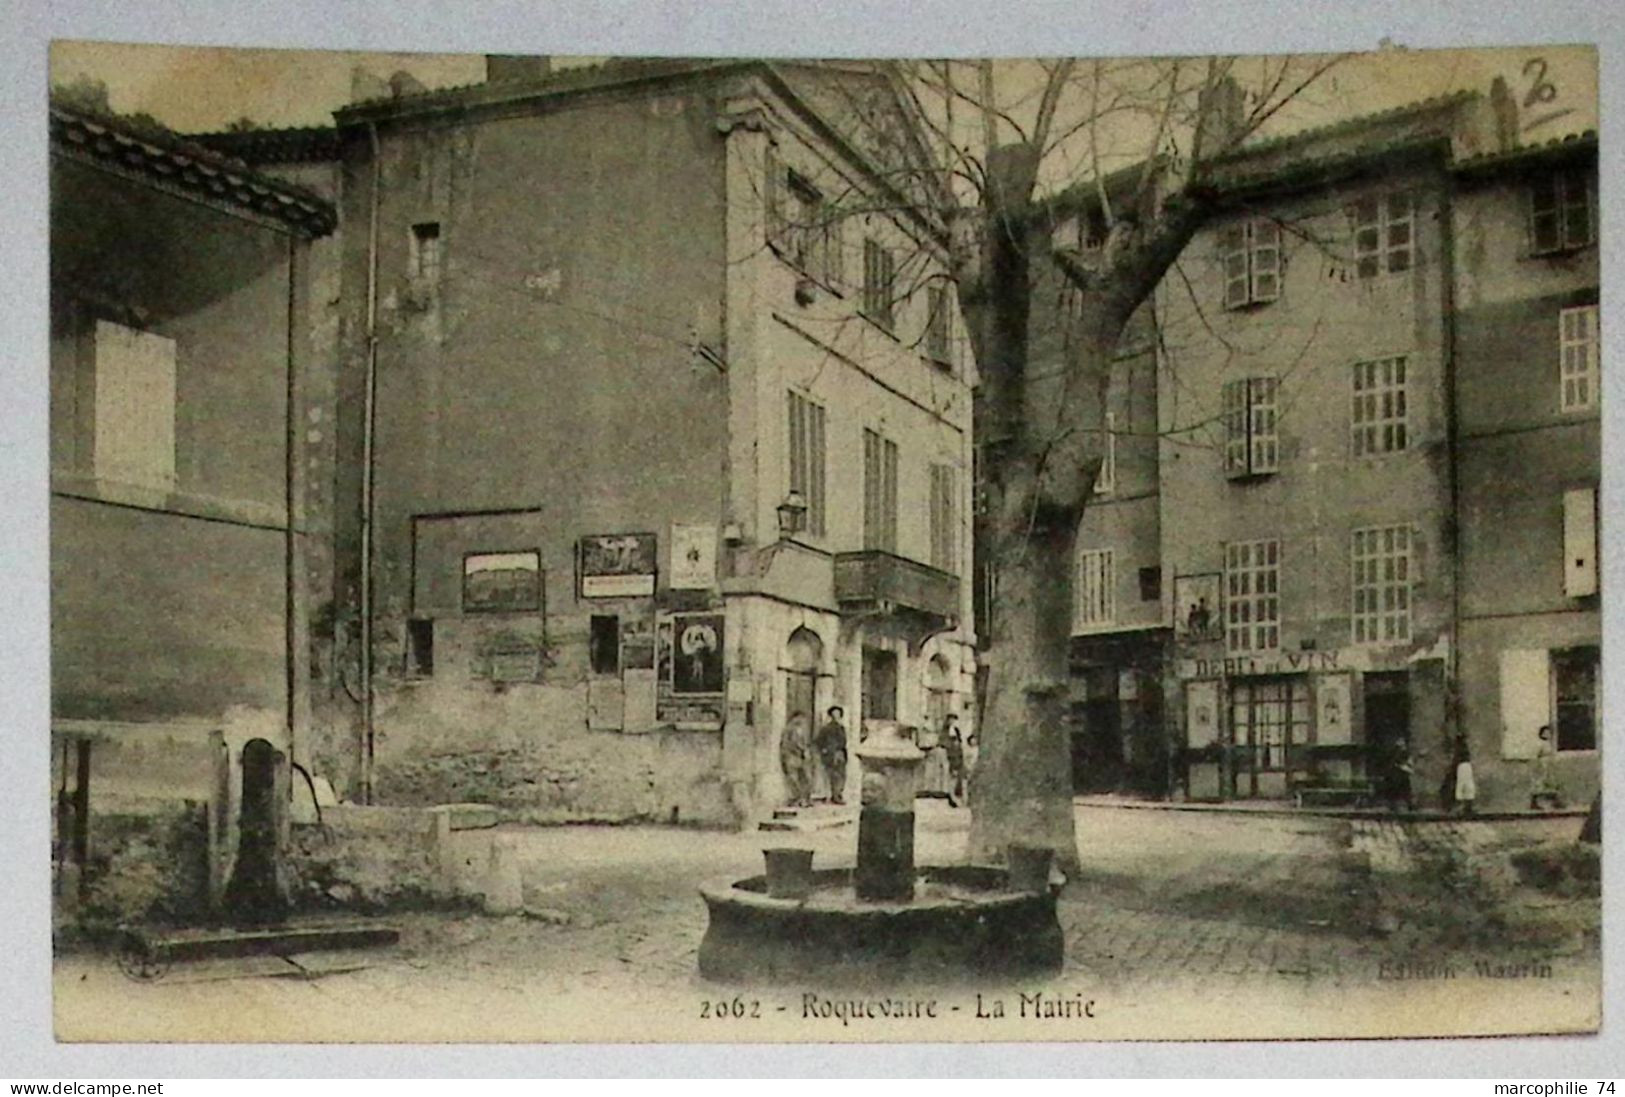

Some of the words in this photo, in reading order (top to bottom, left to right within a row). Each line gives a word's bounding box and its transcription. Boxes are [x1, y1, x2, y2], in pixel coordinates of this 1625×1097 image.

[1288, 651, 1339, 670] VIN
[700, 996, 761, 1019] 2062
[802, 991, 937, 1027] Roquevaire
[975, 993, 1005, 1019] La
[1019, 991, 1096, 1019] Mairie
